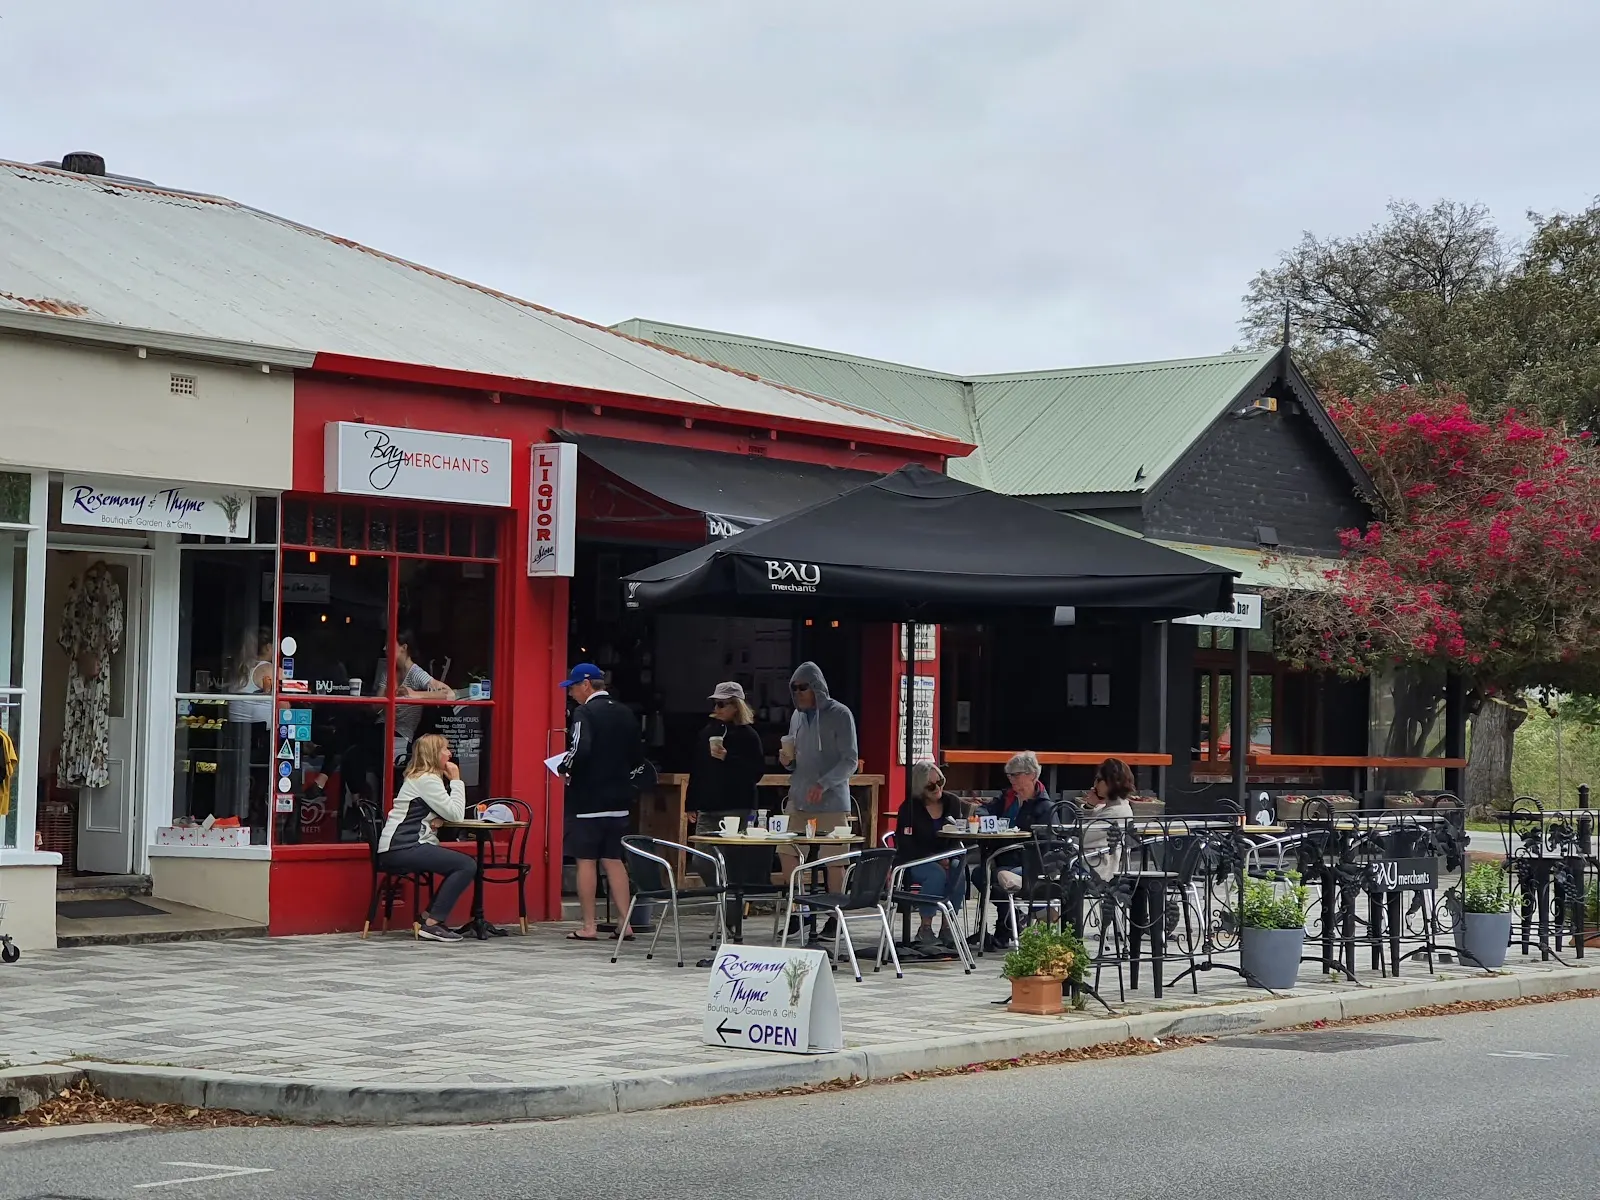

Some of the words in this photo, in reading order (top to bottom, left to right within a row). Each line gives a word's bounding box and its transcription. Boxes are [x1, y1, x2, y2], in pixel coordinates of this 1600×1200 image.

[364, 430, 409, 491] Bay
[404, 452, 489, 474] MERCHANTS
[69, 485, 146, 519] Rosemary
[158, 486, 206, 524] Thyme
[536, 454, 553, 541] LIQUOR
[101, 514, 132, 526] Boutique
[135, 517, 163, 528] Garden
[166, 521, 173, 529] &
[176, 522, 192, 531] Gifts
[709, 521, 733, 539] BAY
[532, 546, 554, 563] Store
[765, 560, 821, 586] BAY
[771, 583, 817, 593] merchants
[1236, 601, 1250, 616] bar
[315, 680, 334, 693] BAY
[771, 820, 782, 832] 18
[983, 818, 995, 830] 19
[1398, 869, 1430, 885] merchants
[716, 953, 787, 983] Rosemary
[726, 976, 769, 1015] Thyme
[707, 1003, 738, 1016] Boutique
[745, 1006, 772, 1017] Garden
[772, 1008, 778, 1016] &
[781, 1009, 797, 1019] Gifts
[748, 1023, 797, 1047] OPEN
